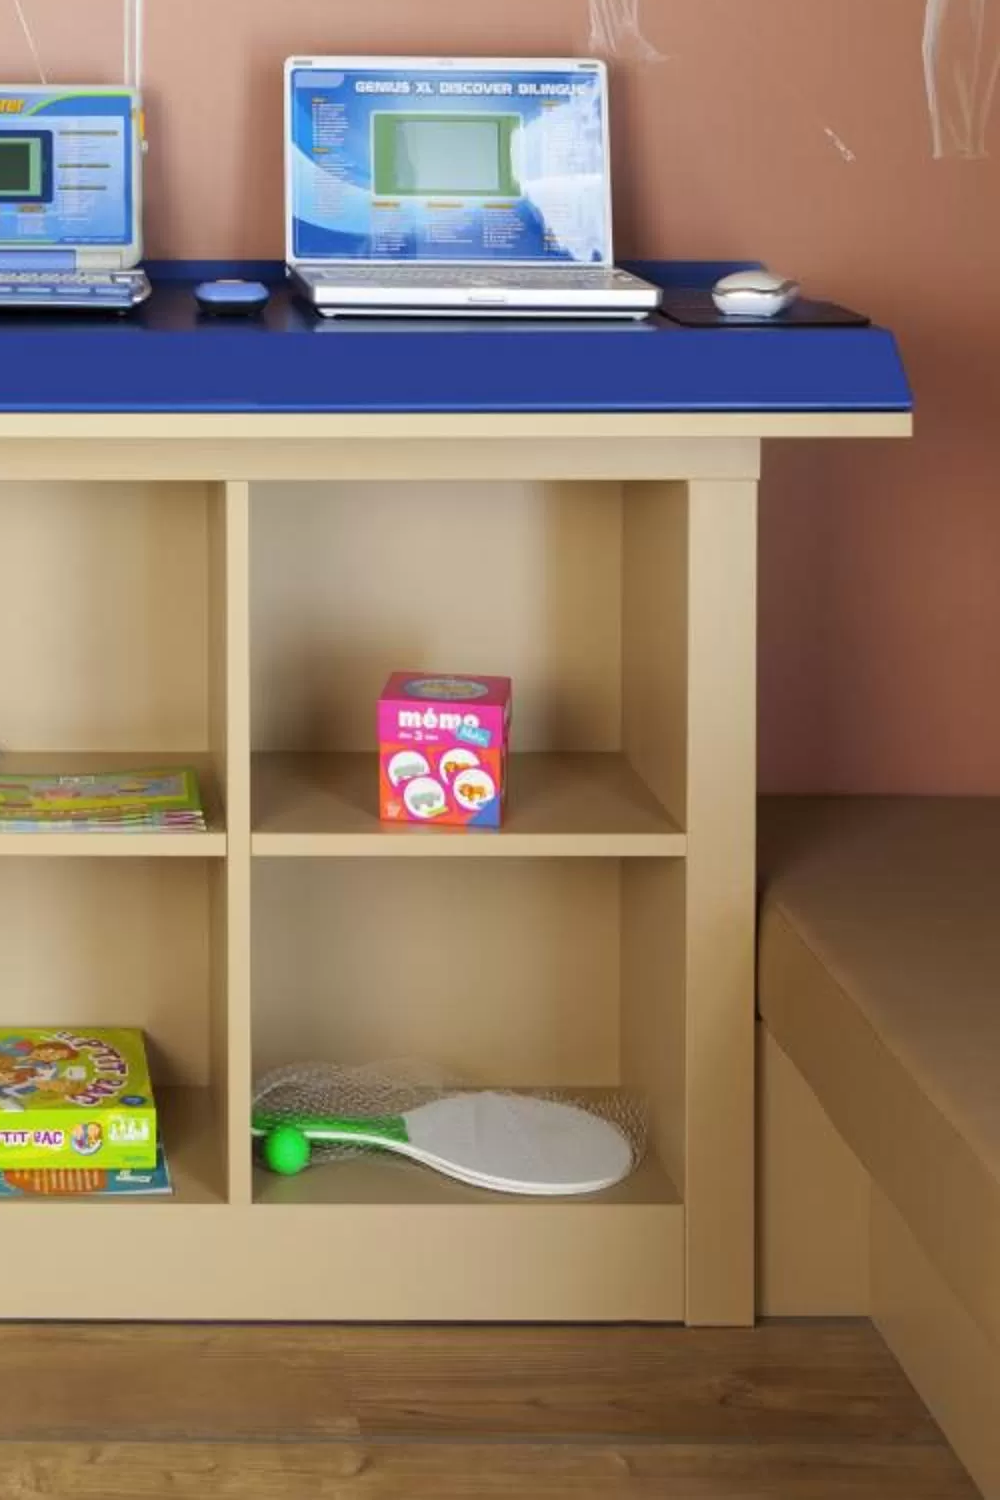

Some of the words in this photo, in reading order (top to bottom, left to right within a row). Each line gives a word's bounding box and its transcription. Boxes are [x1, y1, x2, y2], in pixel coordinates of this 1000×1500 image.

[355, 80, 410, 94] GENIUS
[415, 82, 434, 94] XL
[439, 82, 513, 95] DISCOVER
[33, 1131, 64, 1146] BAC
